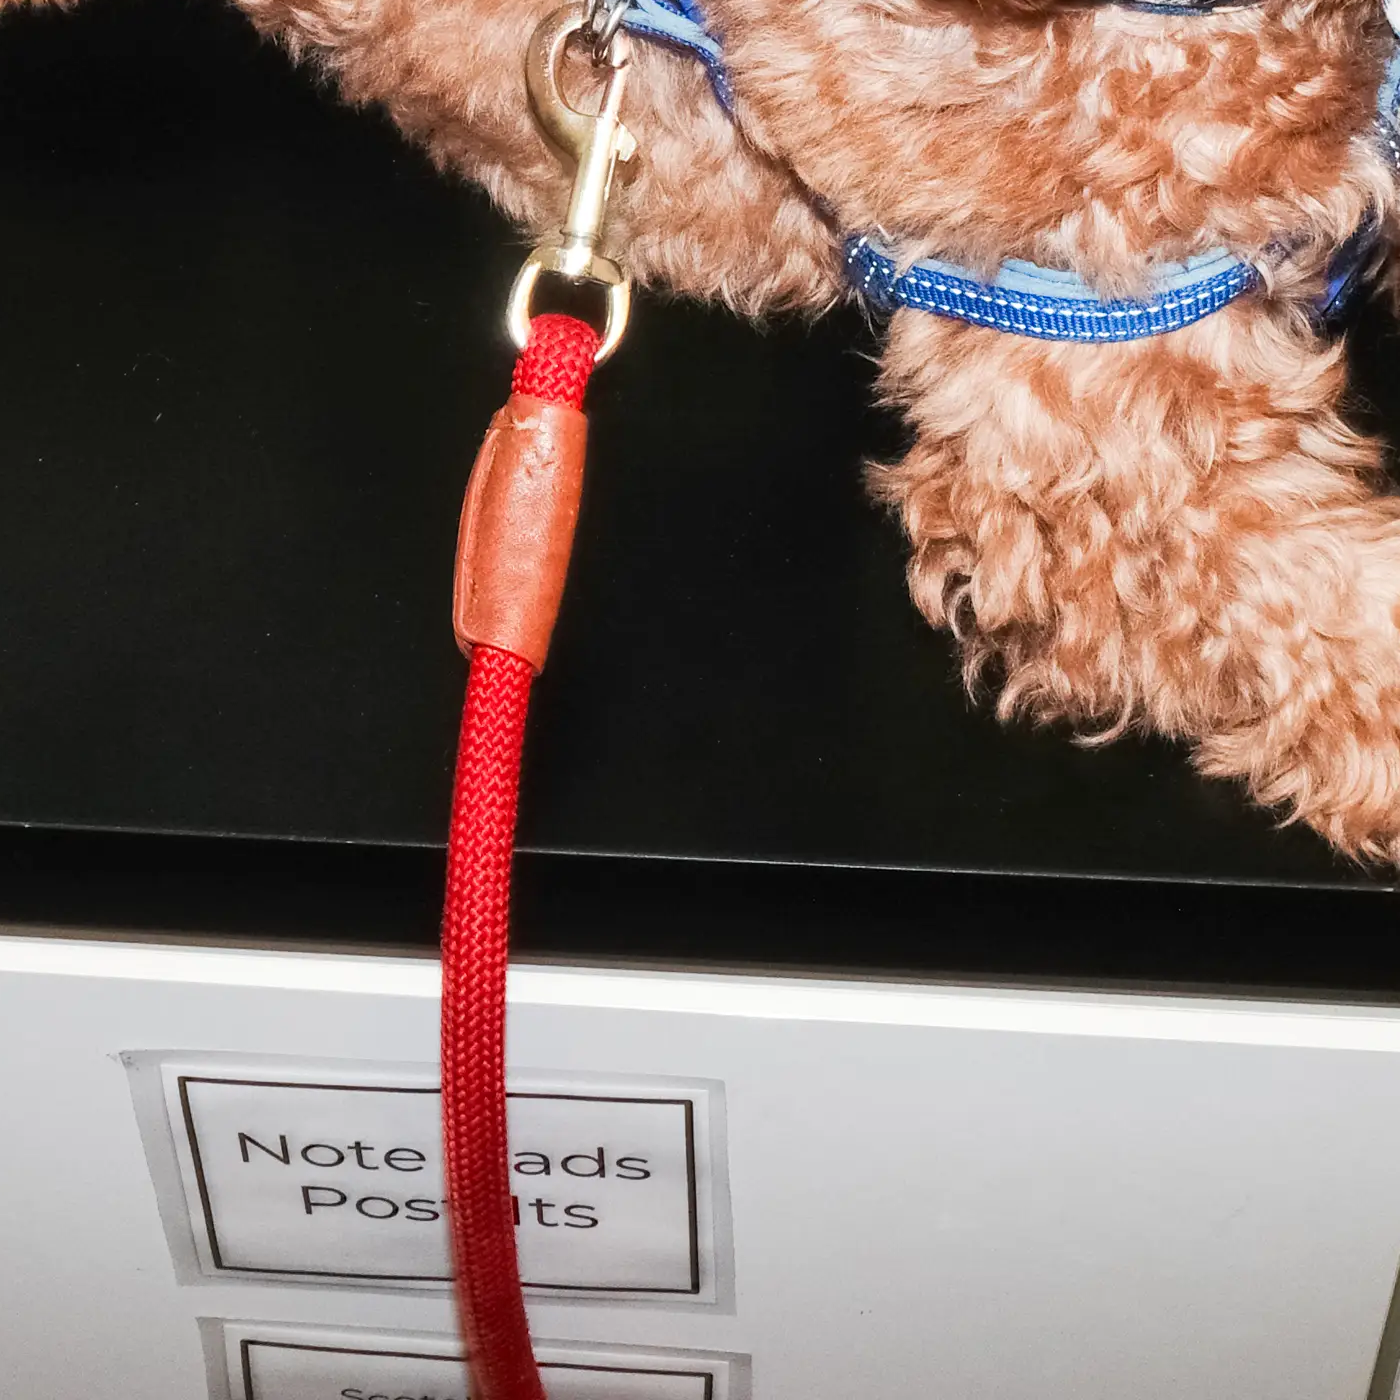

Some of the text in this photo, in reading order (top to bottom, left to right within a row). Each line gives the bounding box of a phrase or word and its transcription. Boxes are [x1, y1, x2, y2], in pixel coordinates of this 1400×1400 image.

[236, 1130, 652, 1181] Note ads
[300, 1184, 450, 1223] Pos
